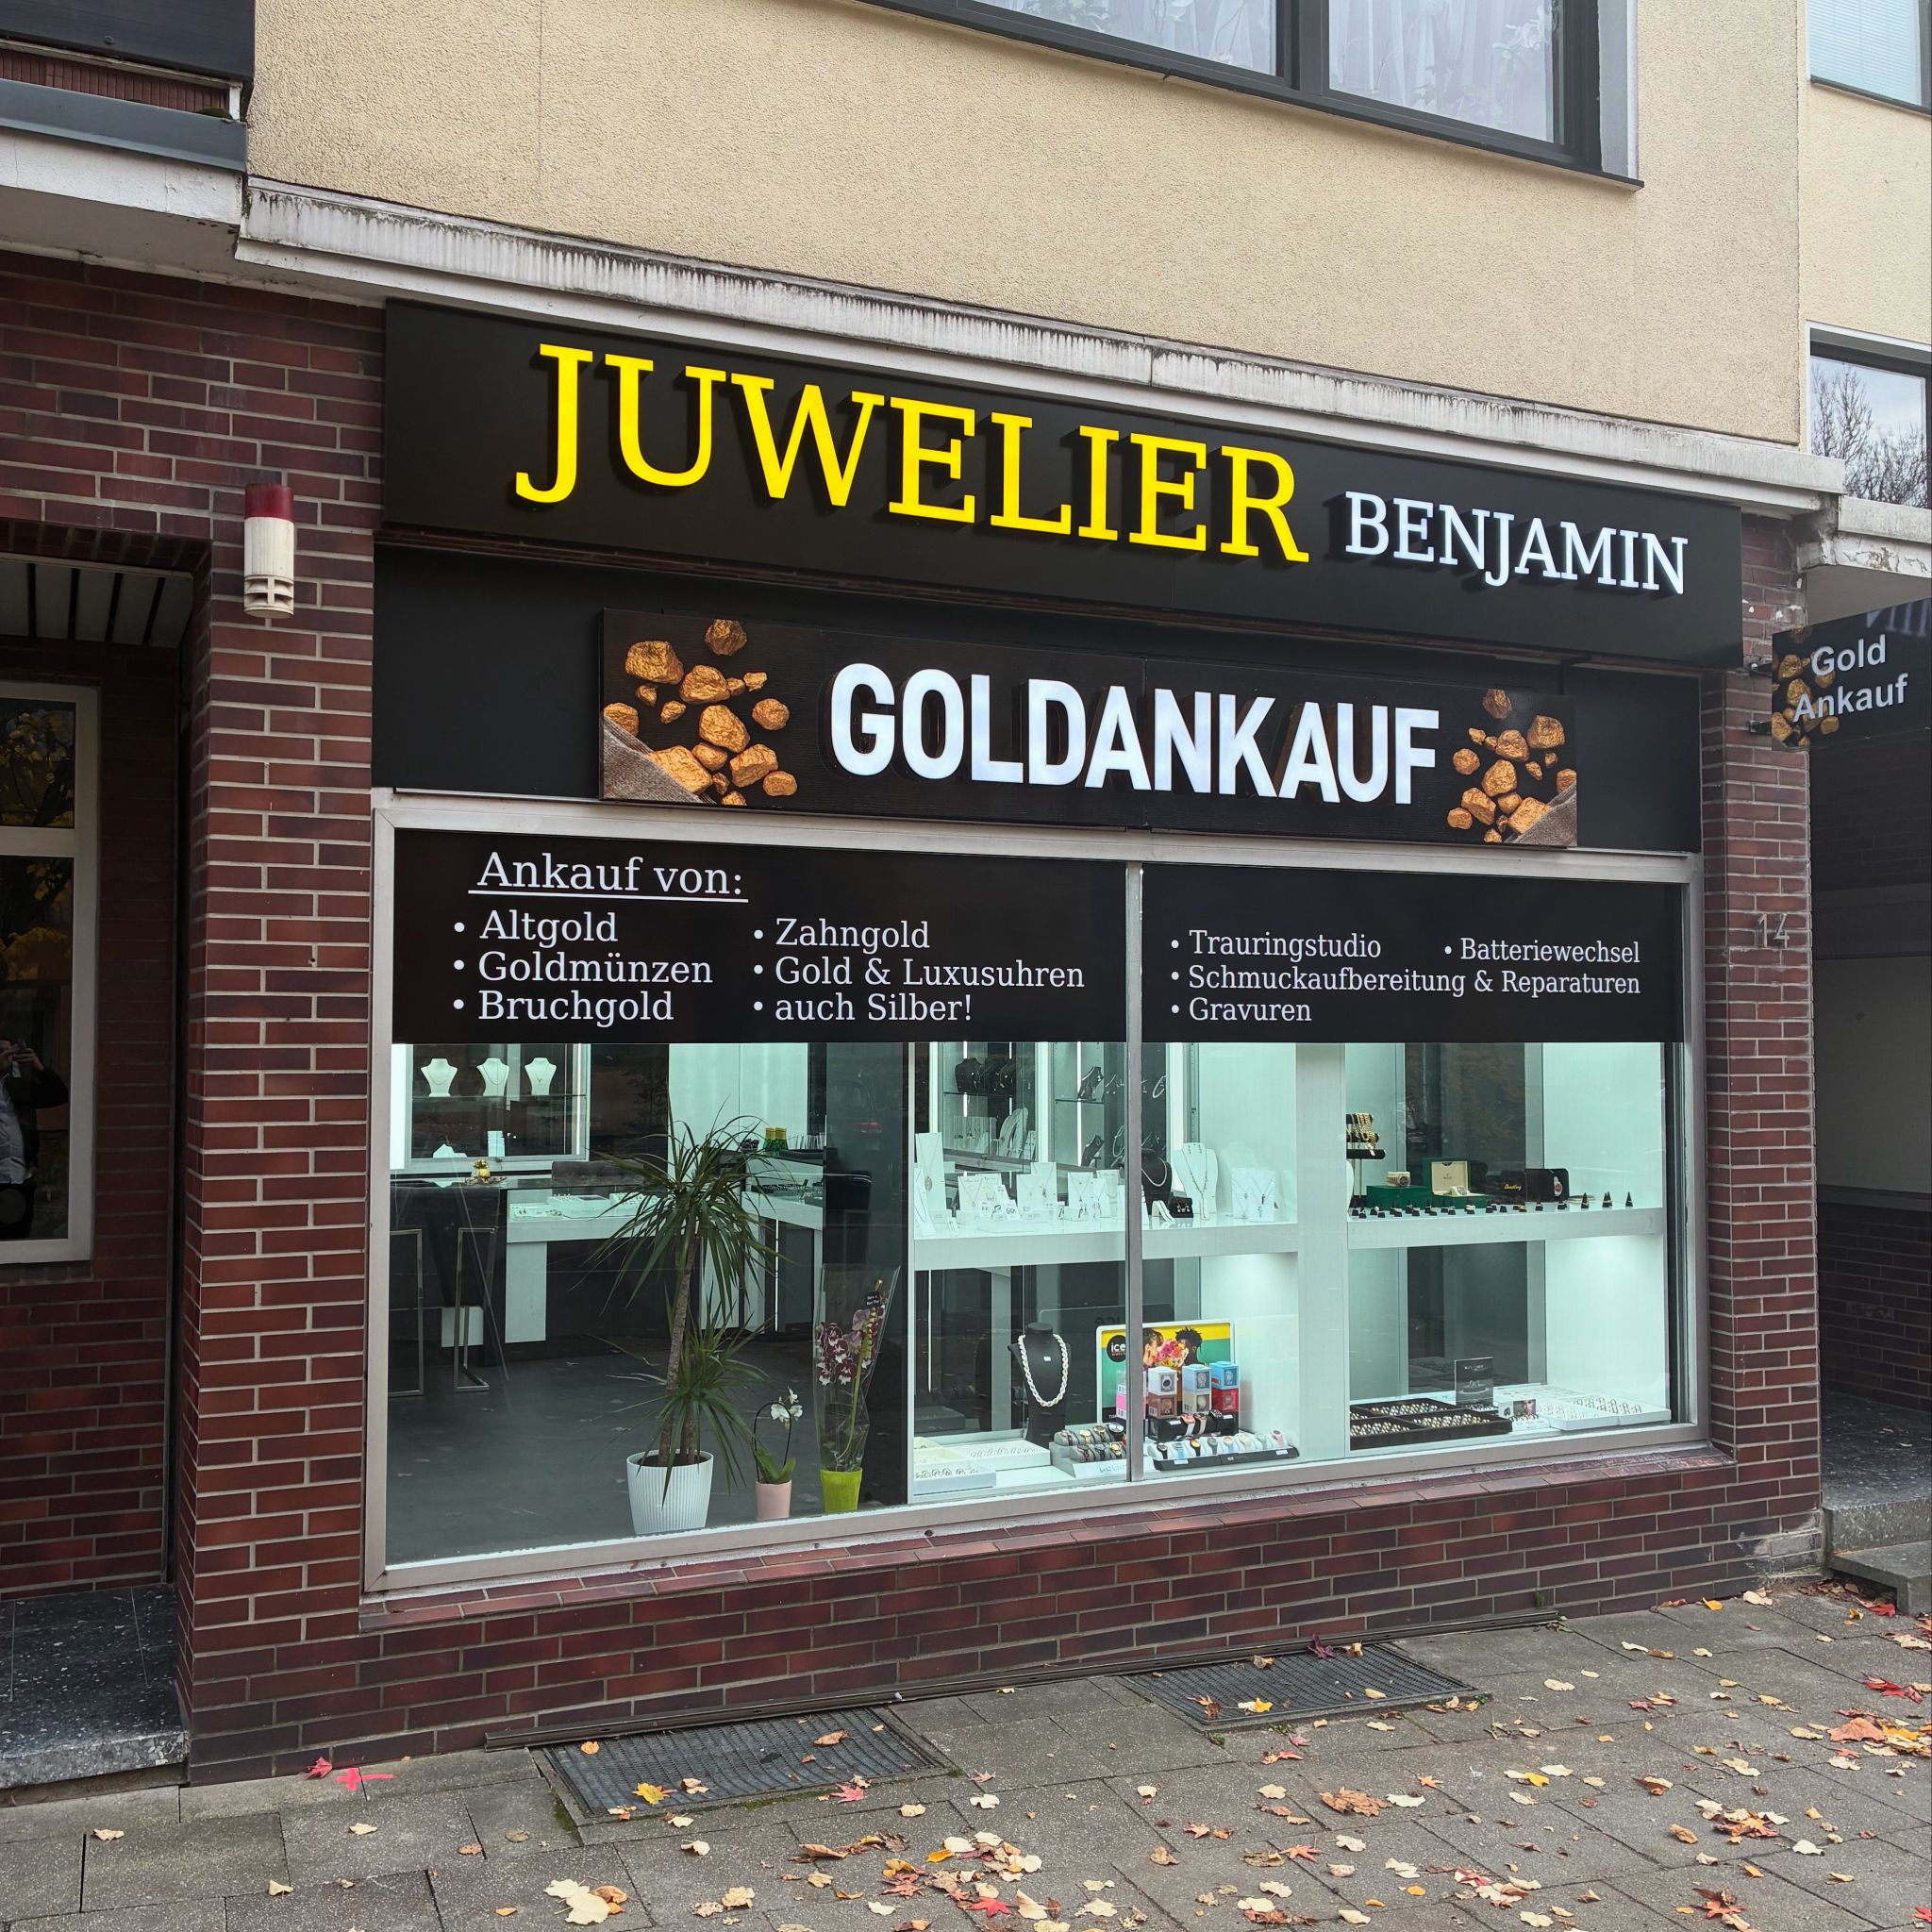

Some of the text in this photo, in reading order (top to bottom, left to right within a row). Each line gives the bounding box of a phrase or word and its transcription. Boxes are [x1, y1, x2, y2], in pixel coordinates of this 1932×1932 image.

[515, 343, 1689, 595] JUWELIER BENJAMIN
[1810, 633, 1886, 676] Gold
[1792, 672, 1908, 723] Ankauf
[830, 662, 1440, 806] GOLDANKAUF
[476, 851, 742, 895] Ankauf von:
[478, 909, 619, 948] Altgold
[775, 917, 931, 954] Zahngold
[1189, 929, 1381, 962] Trauringstudio
[1757, 912, 1790, 949] 14
[478, 951, 713, 983] Goldmünzen
[1459, 937, 1641, 963] Batteriewechsel
[775, 956, 1085, 988] Gold & Luxusuhren
[1189, 964, 1641, 998] Schmuckaufbereitung & Reparaturen
[478, 991, 675, 1028] Bruchgold
[774, 992, 972, 1021] auch Silber!
[1189, 996, 1312, 1022] Gravuren
